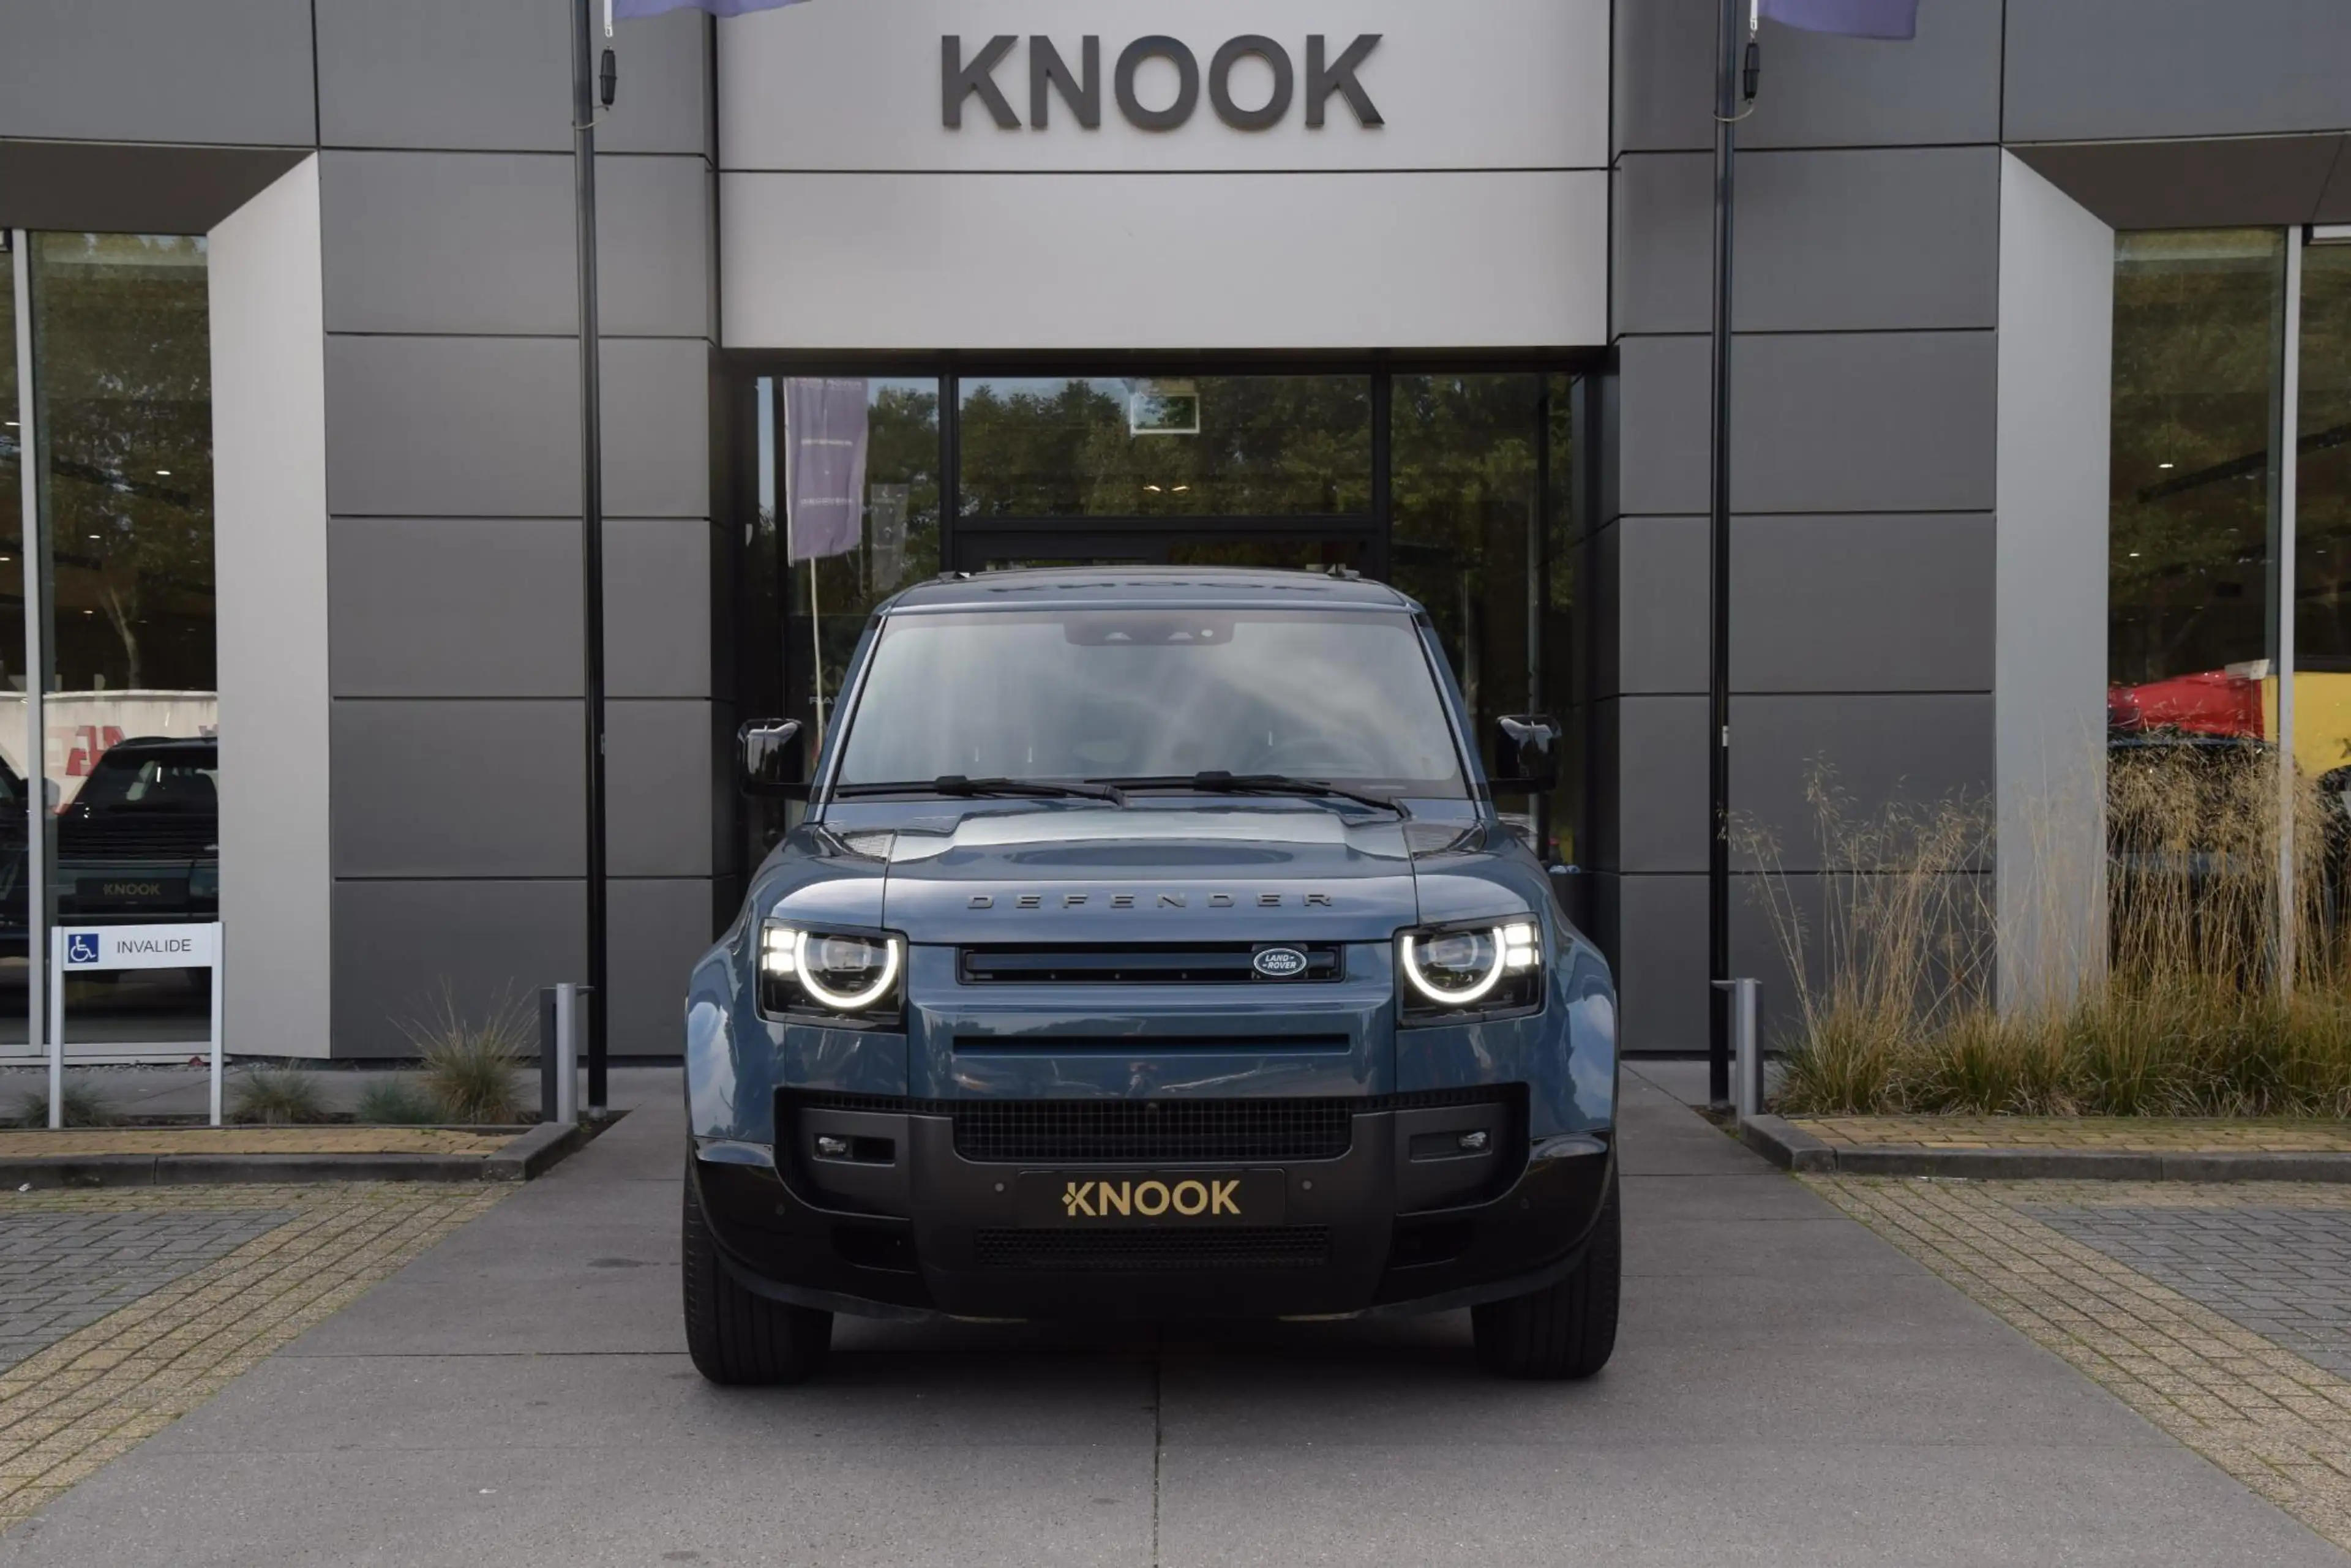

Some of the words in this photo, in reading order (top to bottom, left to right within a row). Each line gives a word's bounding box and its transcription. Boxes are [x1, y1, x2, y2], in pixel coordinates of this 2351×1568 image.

[942, 34, 1385, 133] KNOOK
[102, 883, 161, 896] KNOOK
[967, 892, 1332, 909] DEFENDER
[117, 939, 192, 954] INVALIDE
[1062, 1180, 1241, 1216] KNOOK
